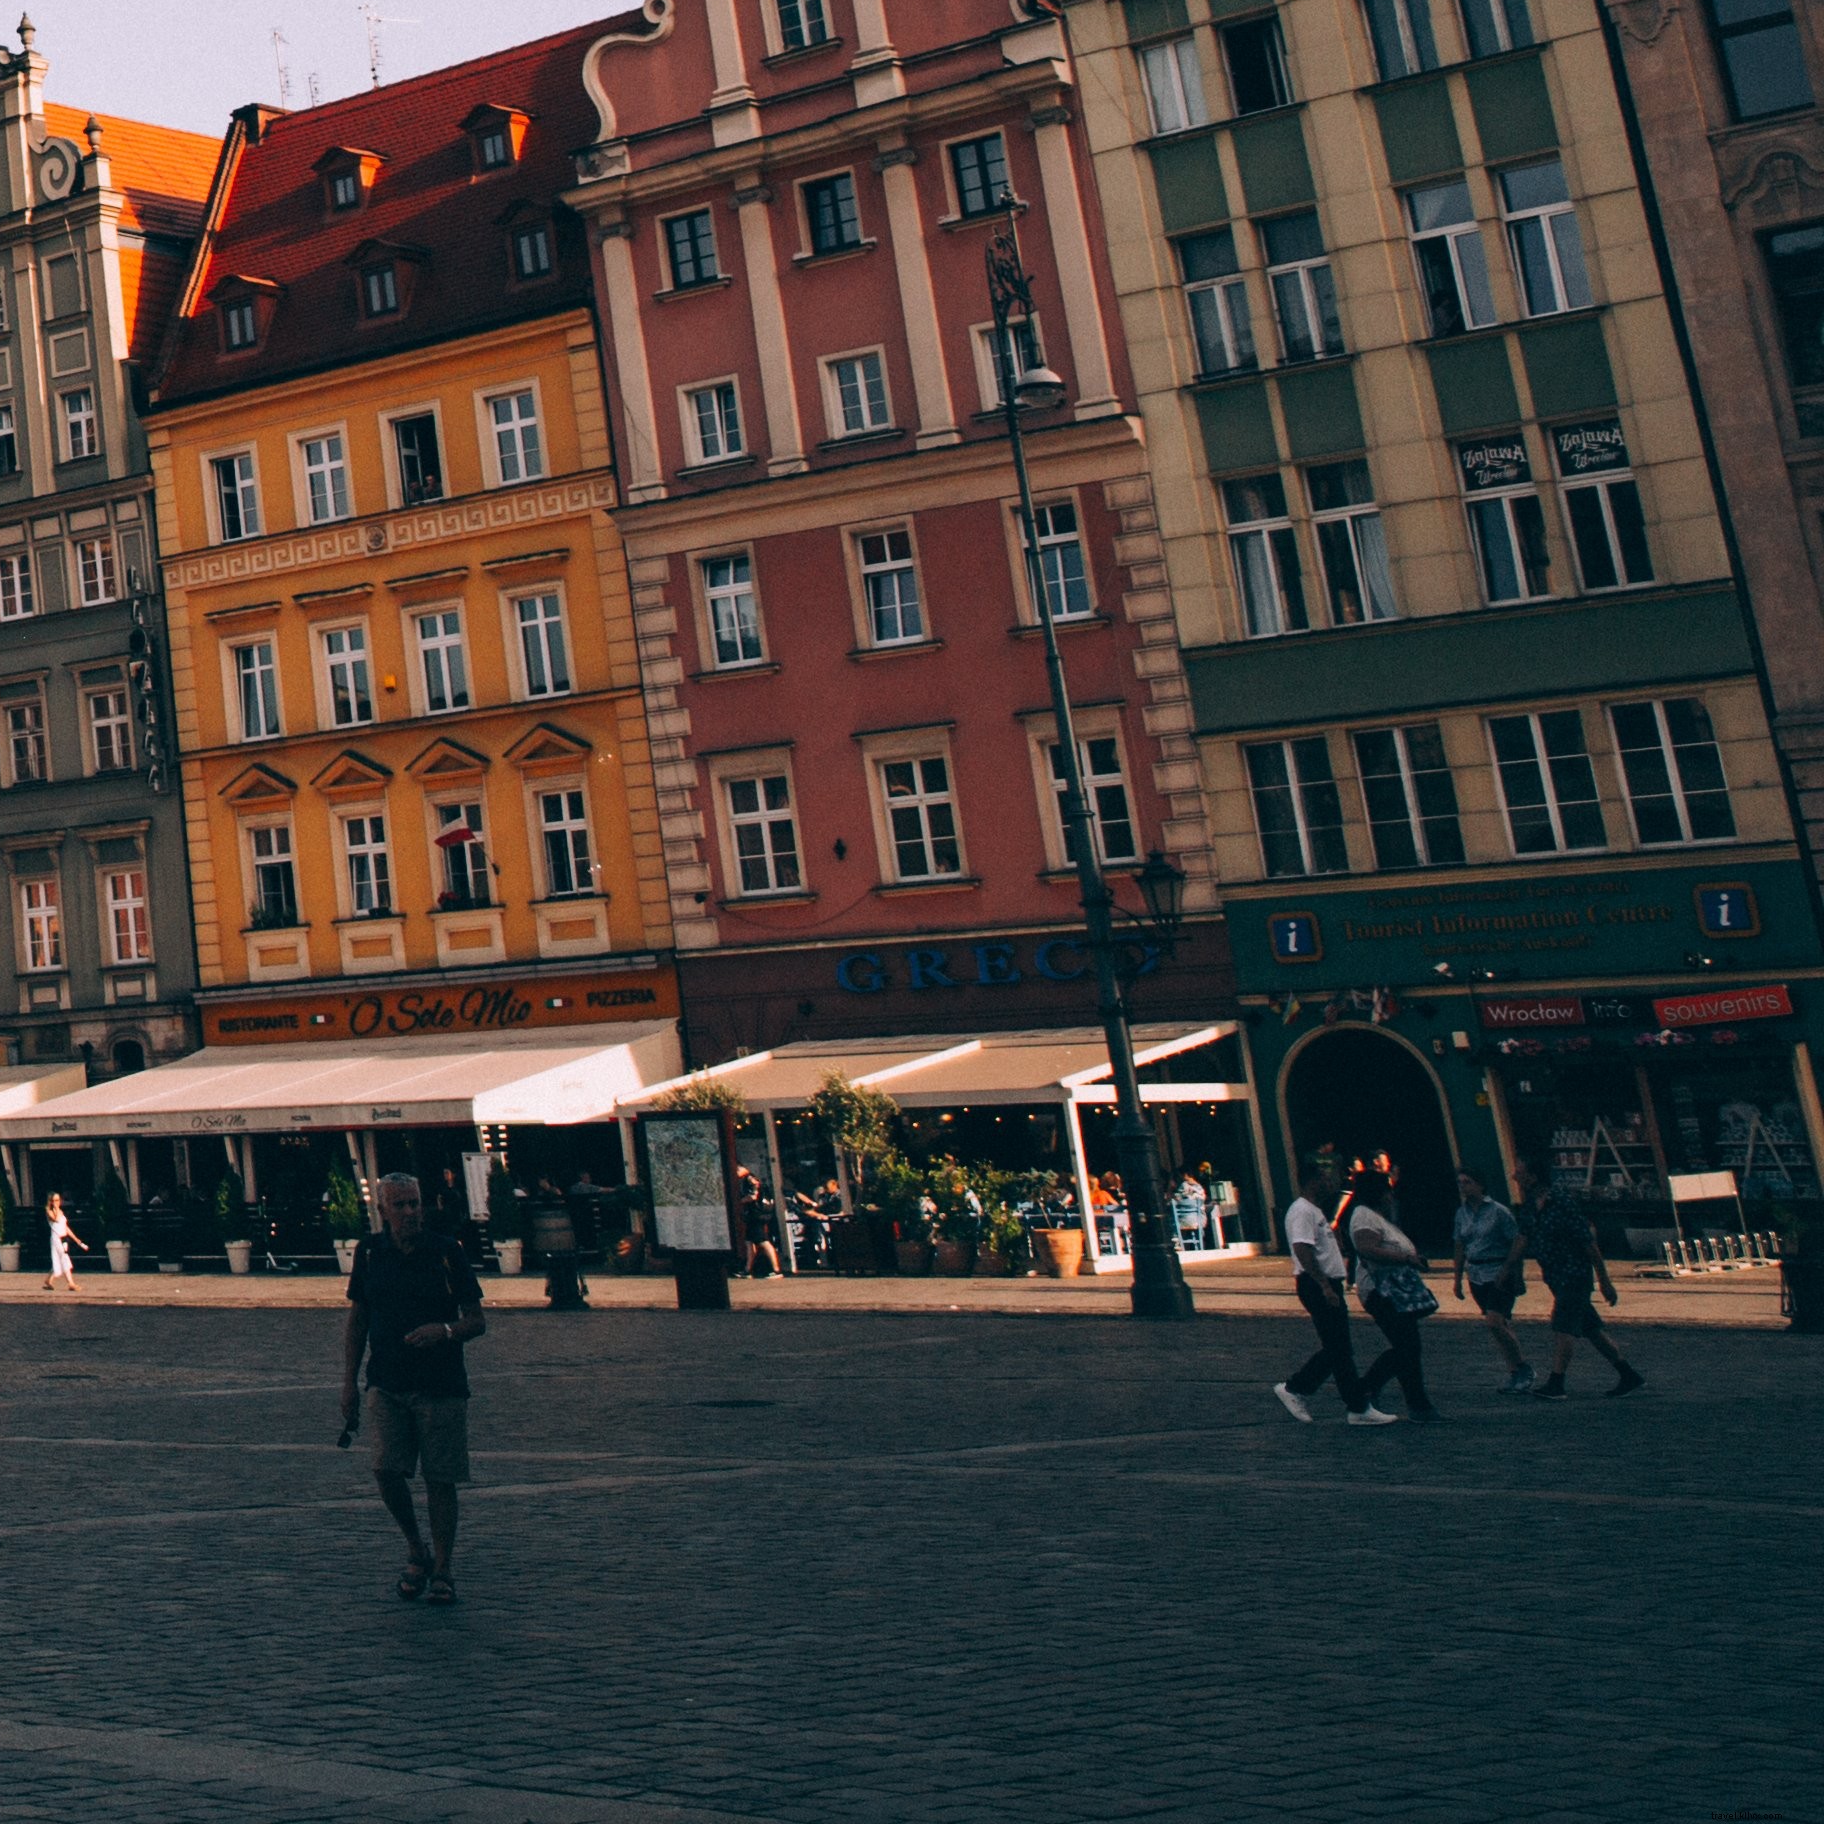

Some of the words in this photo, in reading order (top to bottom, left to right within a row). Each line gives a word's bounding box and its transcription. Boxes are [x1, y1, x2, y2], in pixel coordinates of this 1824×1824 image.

[388, 993, 456, 1036] Sole
[460, 987, 531, 1028] Mio
[587, 988, 656, 1008] PIZZERIA
[1663, 991, 1781, 1023] souvenirs
